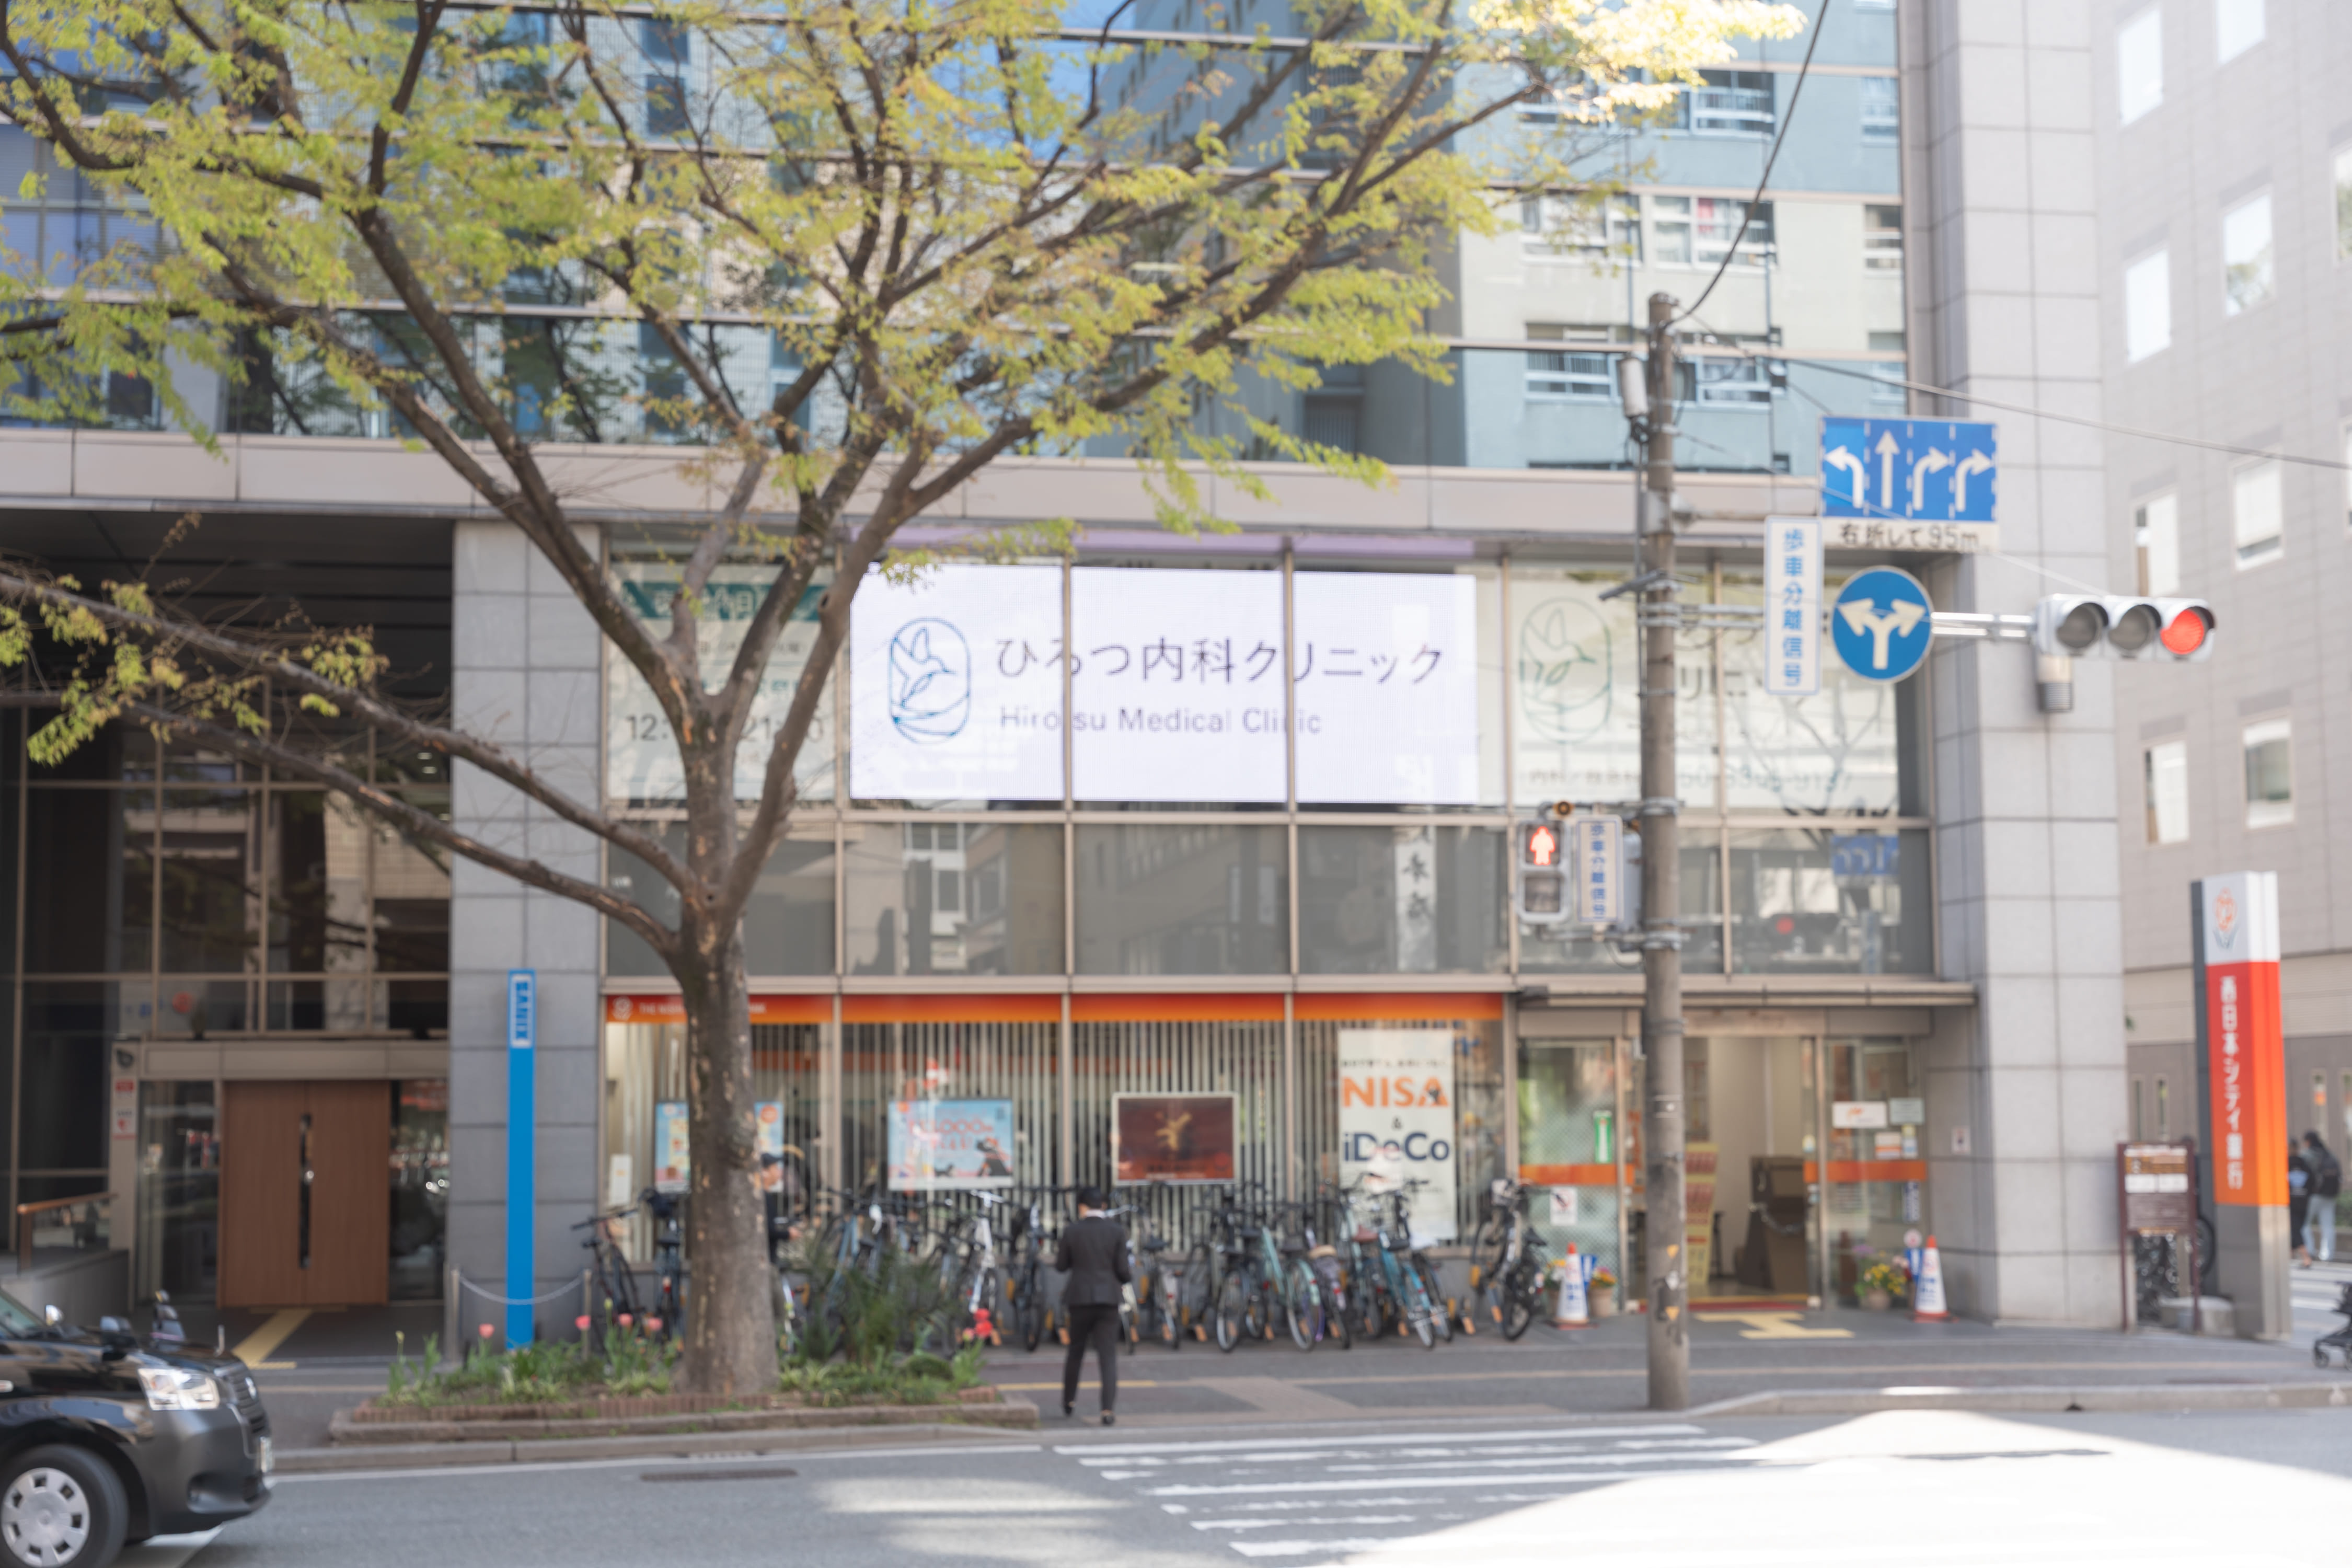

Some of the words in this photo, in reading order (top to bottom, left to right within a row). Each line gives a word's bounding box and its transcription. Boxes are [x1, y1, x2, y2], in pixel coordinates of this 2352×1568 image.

[1783, 527, 1804, 687] 歩車分離信号
[996, 637, 1441, 684] ひろつ内科クリニック
[1000, 706, 1106, 732] Hirosu
[1118, 706, 1231, 733] Medical
[1242, 707, 1322, 734] Cliic
[1341, 1076, 1449, 1108] NISA
[1392, 1116, 1403, 1129] &
[1343, 1132, 1450, 1162] iDeCo
